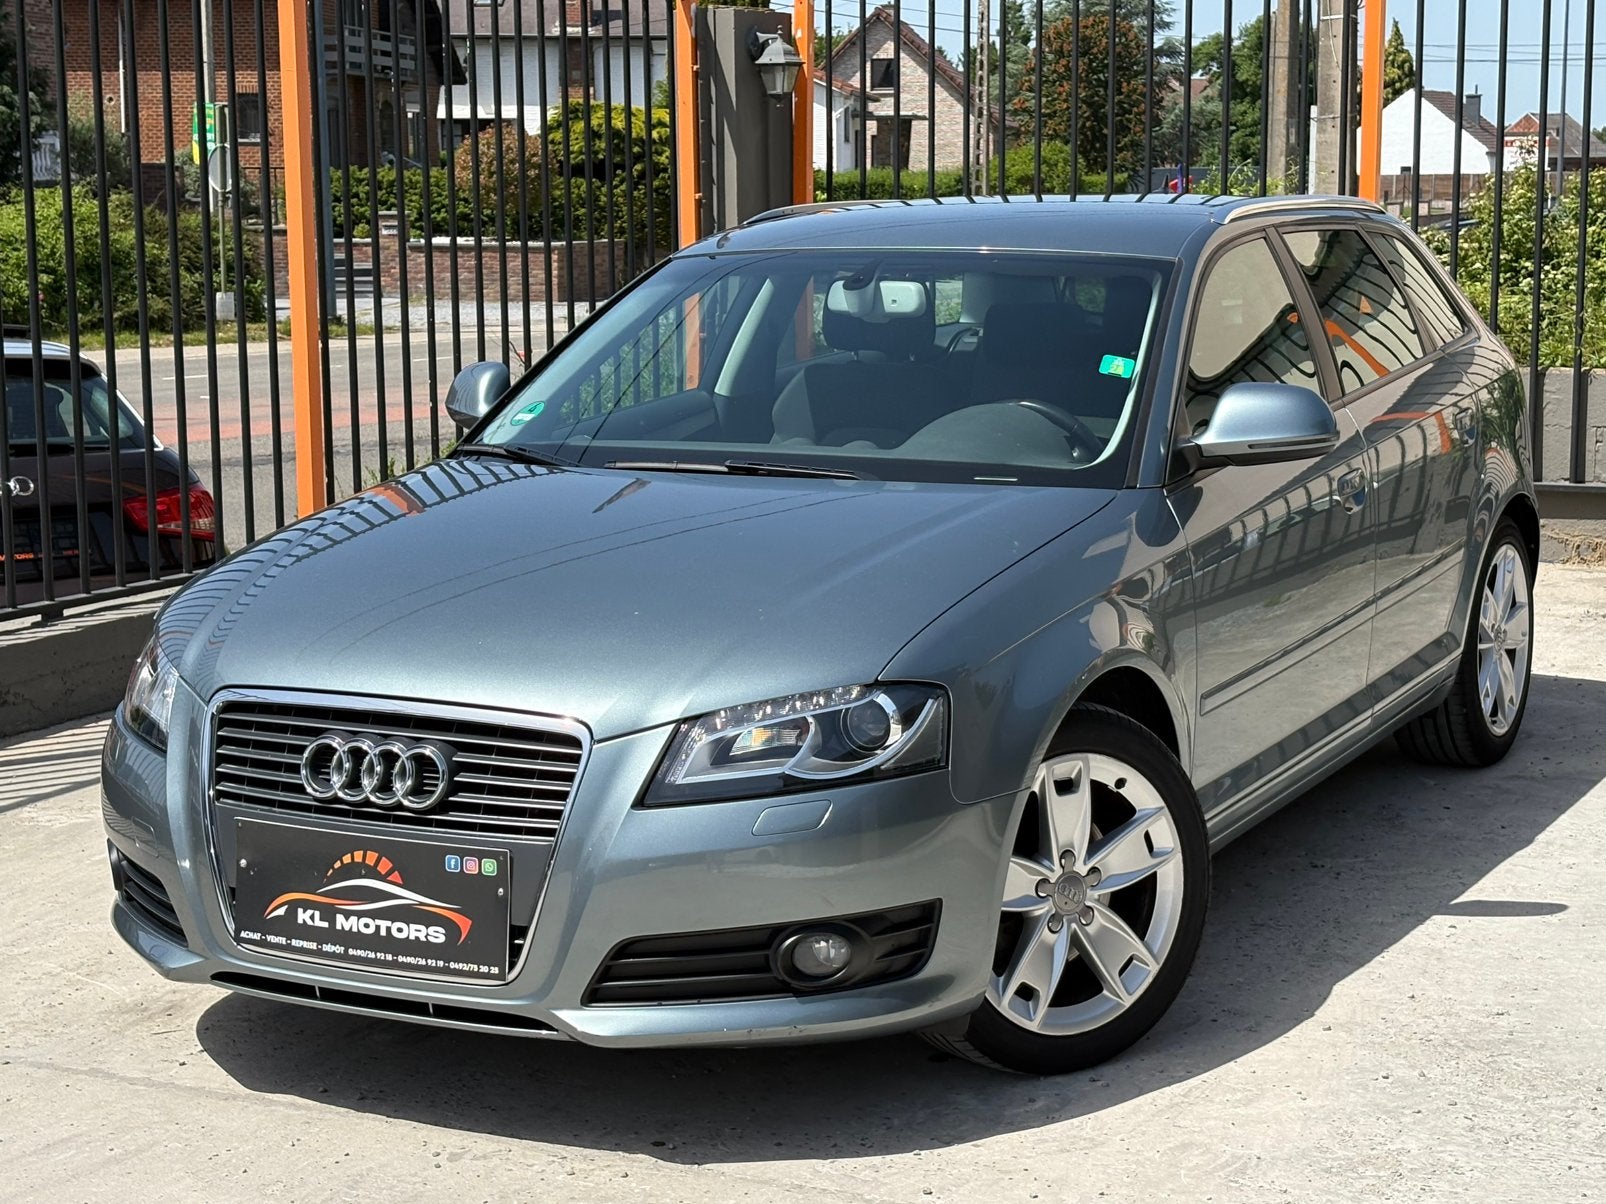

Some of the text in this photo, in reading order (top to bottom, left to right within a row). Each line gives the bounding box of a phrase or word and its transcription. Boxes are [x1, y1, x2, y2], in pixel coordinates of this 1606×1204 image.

[297, 907, 446, 944] KL MOTORS
[240, 930, 262, 940] ACHAT
[266, 934, 287, 945] VENTE
[291, 939, 317, 950] REPRISE
[348, 948, 376, 959] 0490/26
[397, 955, 427, 965] 0490/26
